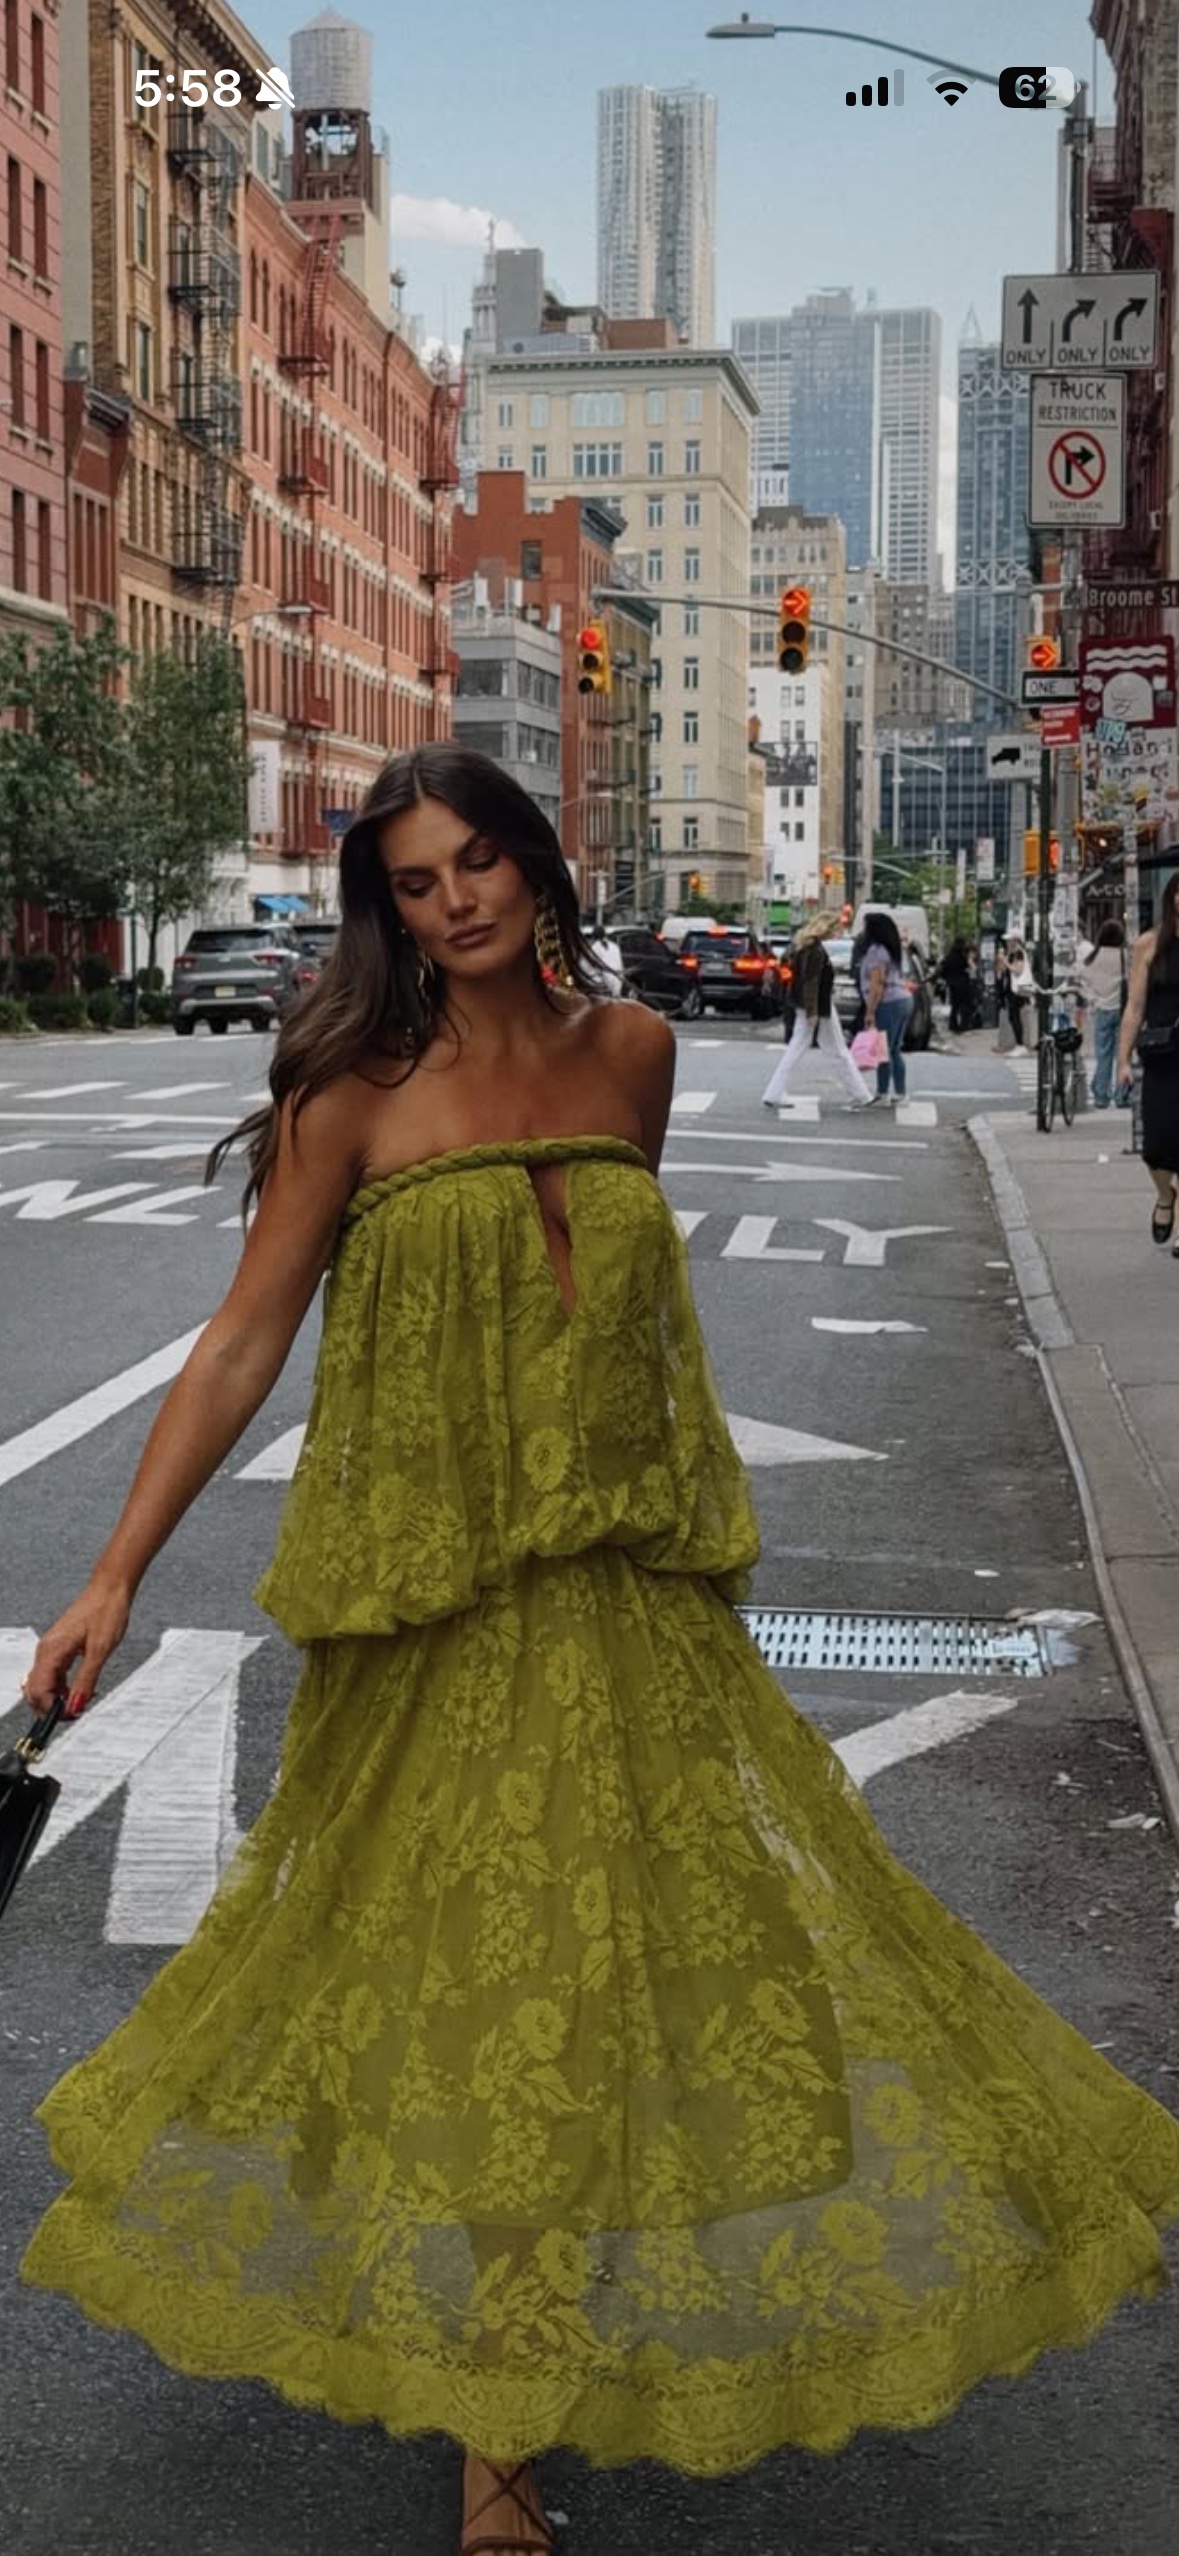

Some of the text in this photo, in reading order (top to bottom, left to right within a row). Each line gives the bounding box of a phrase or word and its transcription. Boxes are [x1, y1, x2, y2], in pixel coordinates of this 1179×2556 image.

[1006, 345, 1150, 364] ONLY ONLY ONLY
[1048, 382, 1106, 400] TRUCK
[1038, 404, 1118, 421] RESTRICTION
[1089, 588, 1155, 607] Broome
[1030, 681, 1056, 695] ONE
